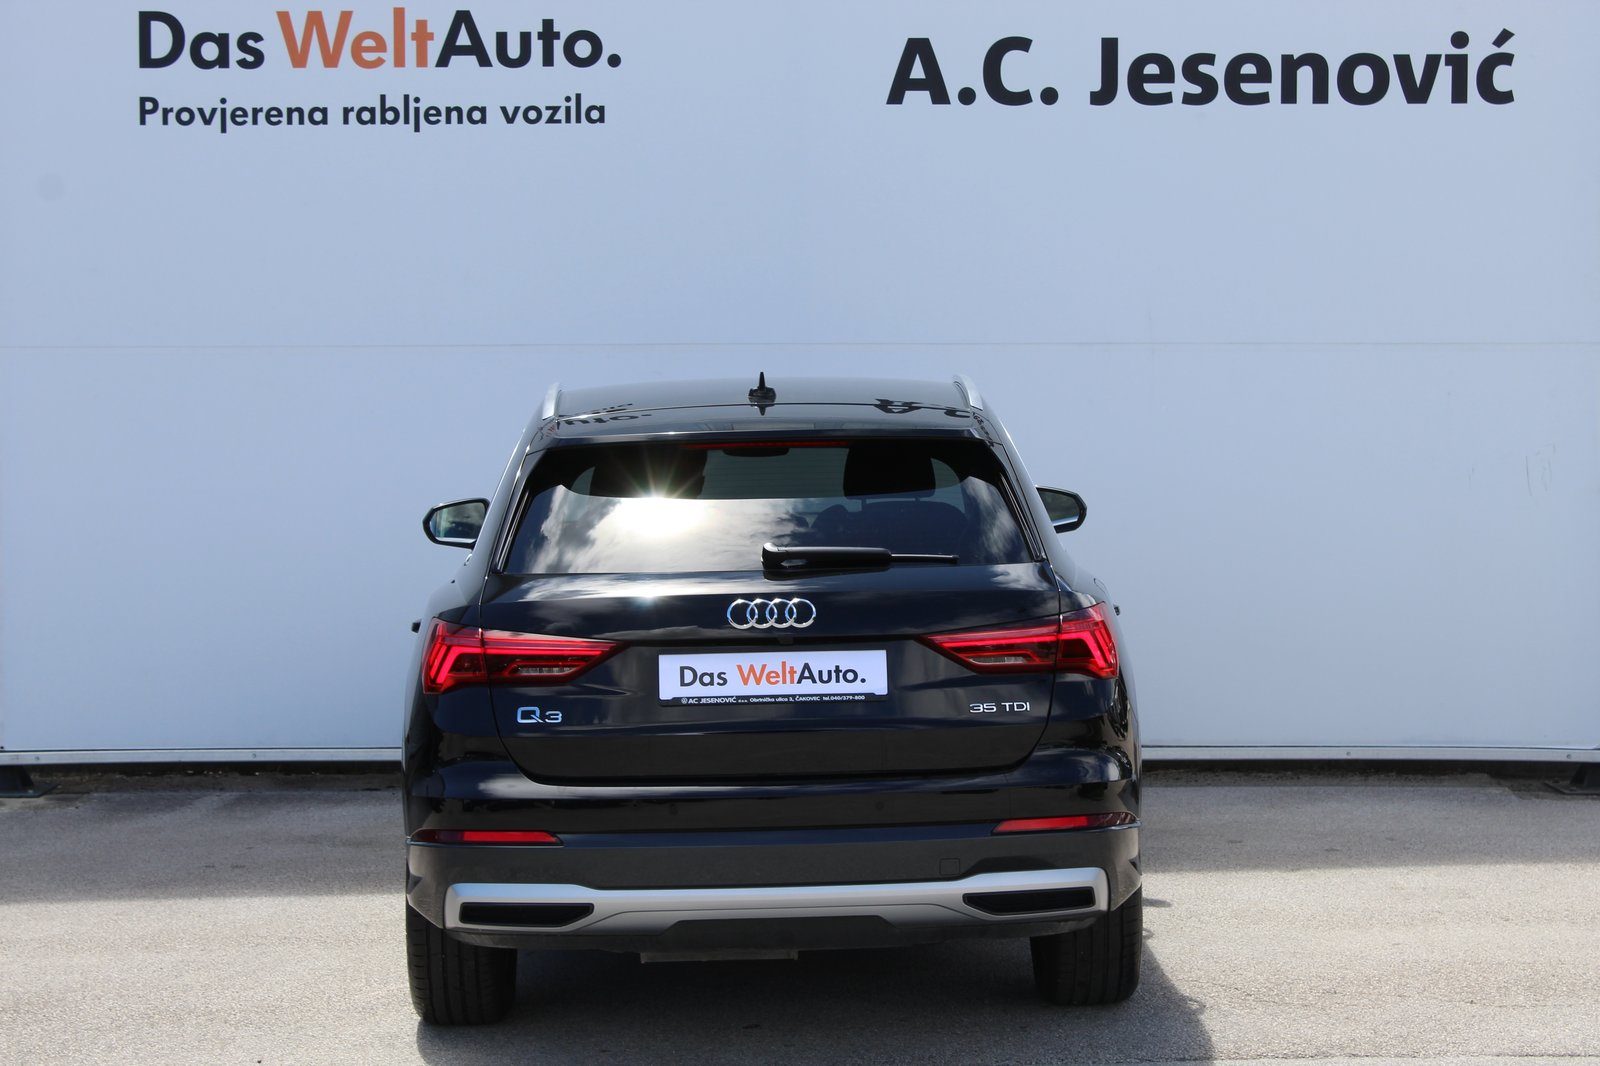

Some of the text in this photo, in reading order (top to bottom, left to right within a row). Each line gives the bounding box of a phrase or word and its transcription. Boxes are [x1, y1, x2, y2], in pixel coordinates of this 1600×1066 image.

[138, 7, 622, 70] Das WeltAuto.
[885, 28, 1515, 107] A.C. Jesenović
[139, 92, 606, 134] Provjerena rabljena vozila
[679, 661, 867, 687] Das WeltAuto.
[699, 696, 737, 704] JESENOVIĆ
[969, 701, 1030, 713] 35 TDI
[516, 706, 563, 723] Q3
